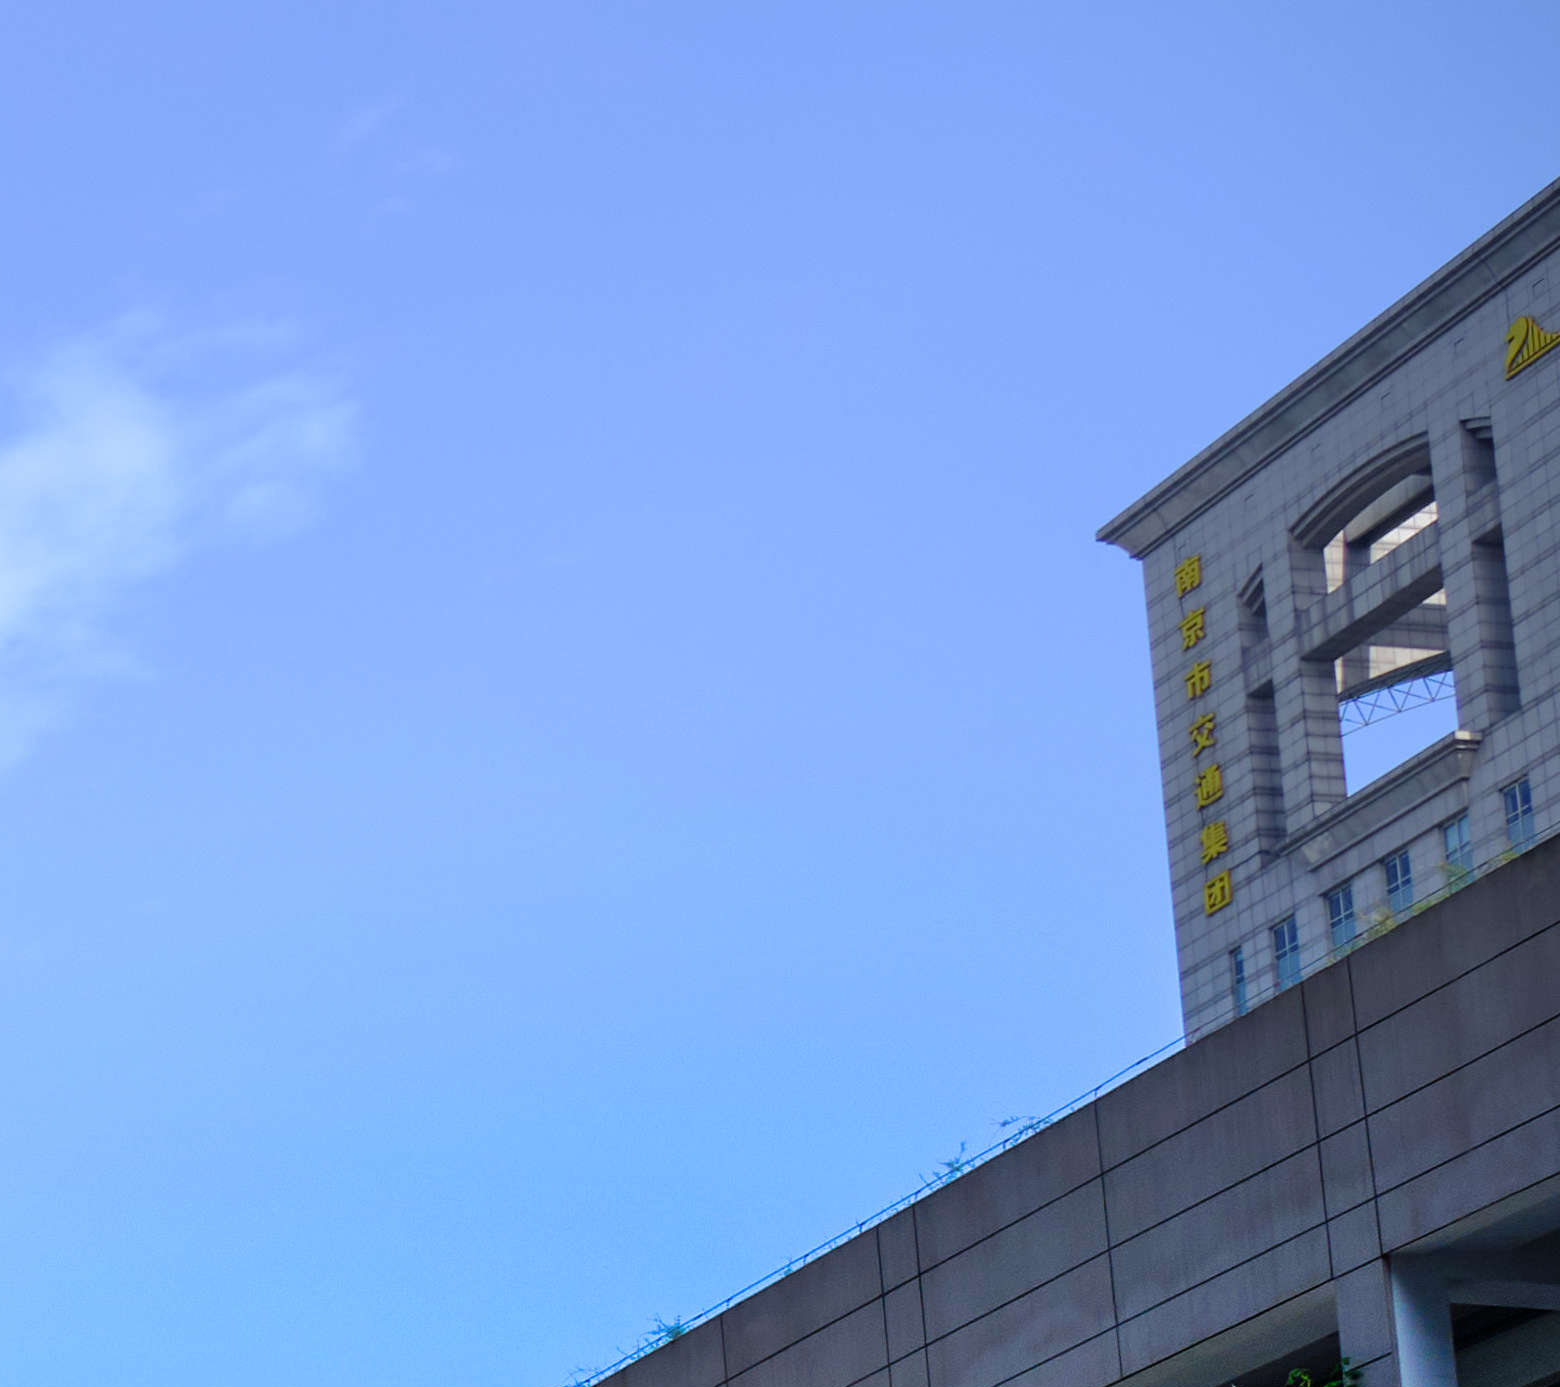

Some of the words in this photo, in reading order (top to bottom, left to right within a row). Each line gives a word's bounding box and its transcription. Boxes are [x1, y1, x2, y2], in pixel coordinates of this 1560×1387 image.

[1174, 553, 1232, 916] 南京市交通集团
